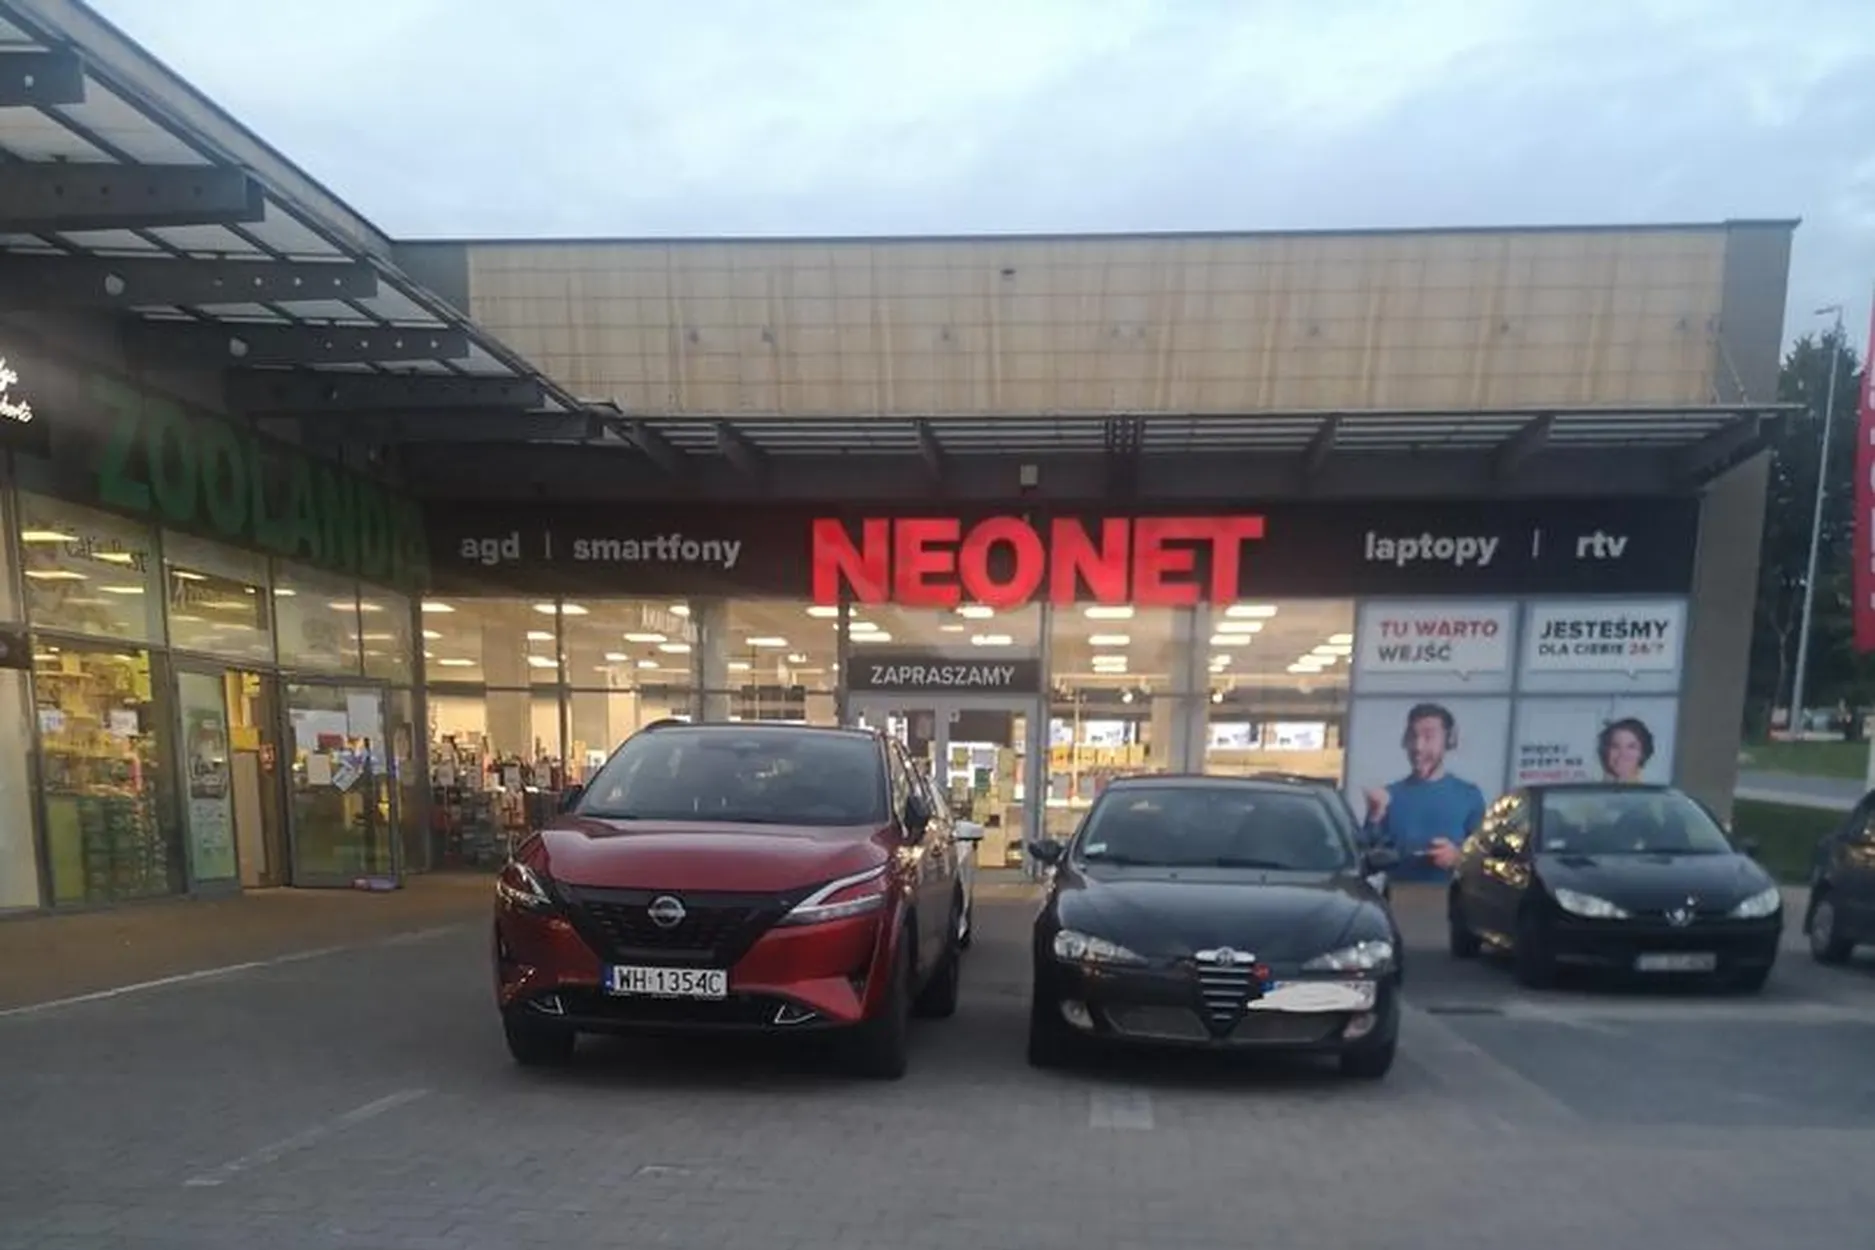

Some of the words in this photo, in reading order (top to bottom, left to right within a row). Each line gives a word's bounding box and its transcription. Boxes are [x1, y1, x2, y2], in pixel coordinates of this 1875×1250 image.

[91, 374, 430, 594] ZOOLANDIA
[461, 532, 519, 565] agd
[573, 533, 741, 568] smartfony
[1365, 531, 1499, 566] laptopy
[1576, 530, 1628, 558] rtv
[812, 516, 1265, 610] NEONET
[1381, 621, 1408, 638] TU
[1415, 619, 1499, 638] WARTO
[1539, 615, 1668, 639] JESTEŚMY
[1539, 643, 1569, 655] DLA
[870, 666, 1015, 686] ZAPRASZAMY
[618, 969, 647, 990] WH
[656, 970, 722, 994] 1354C
